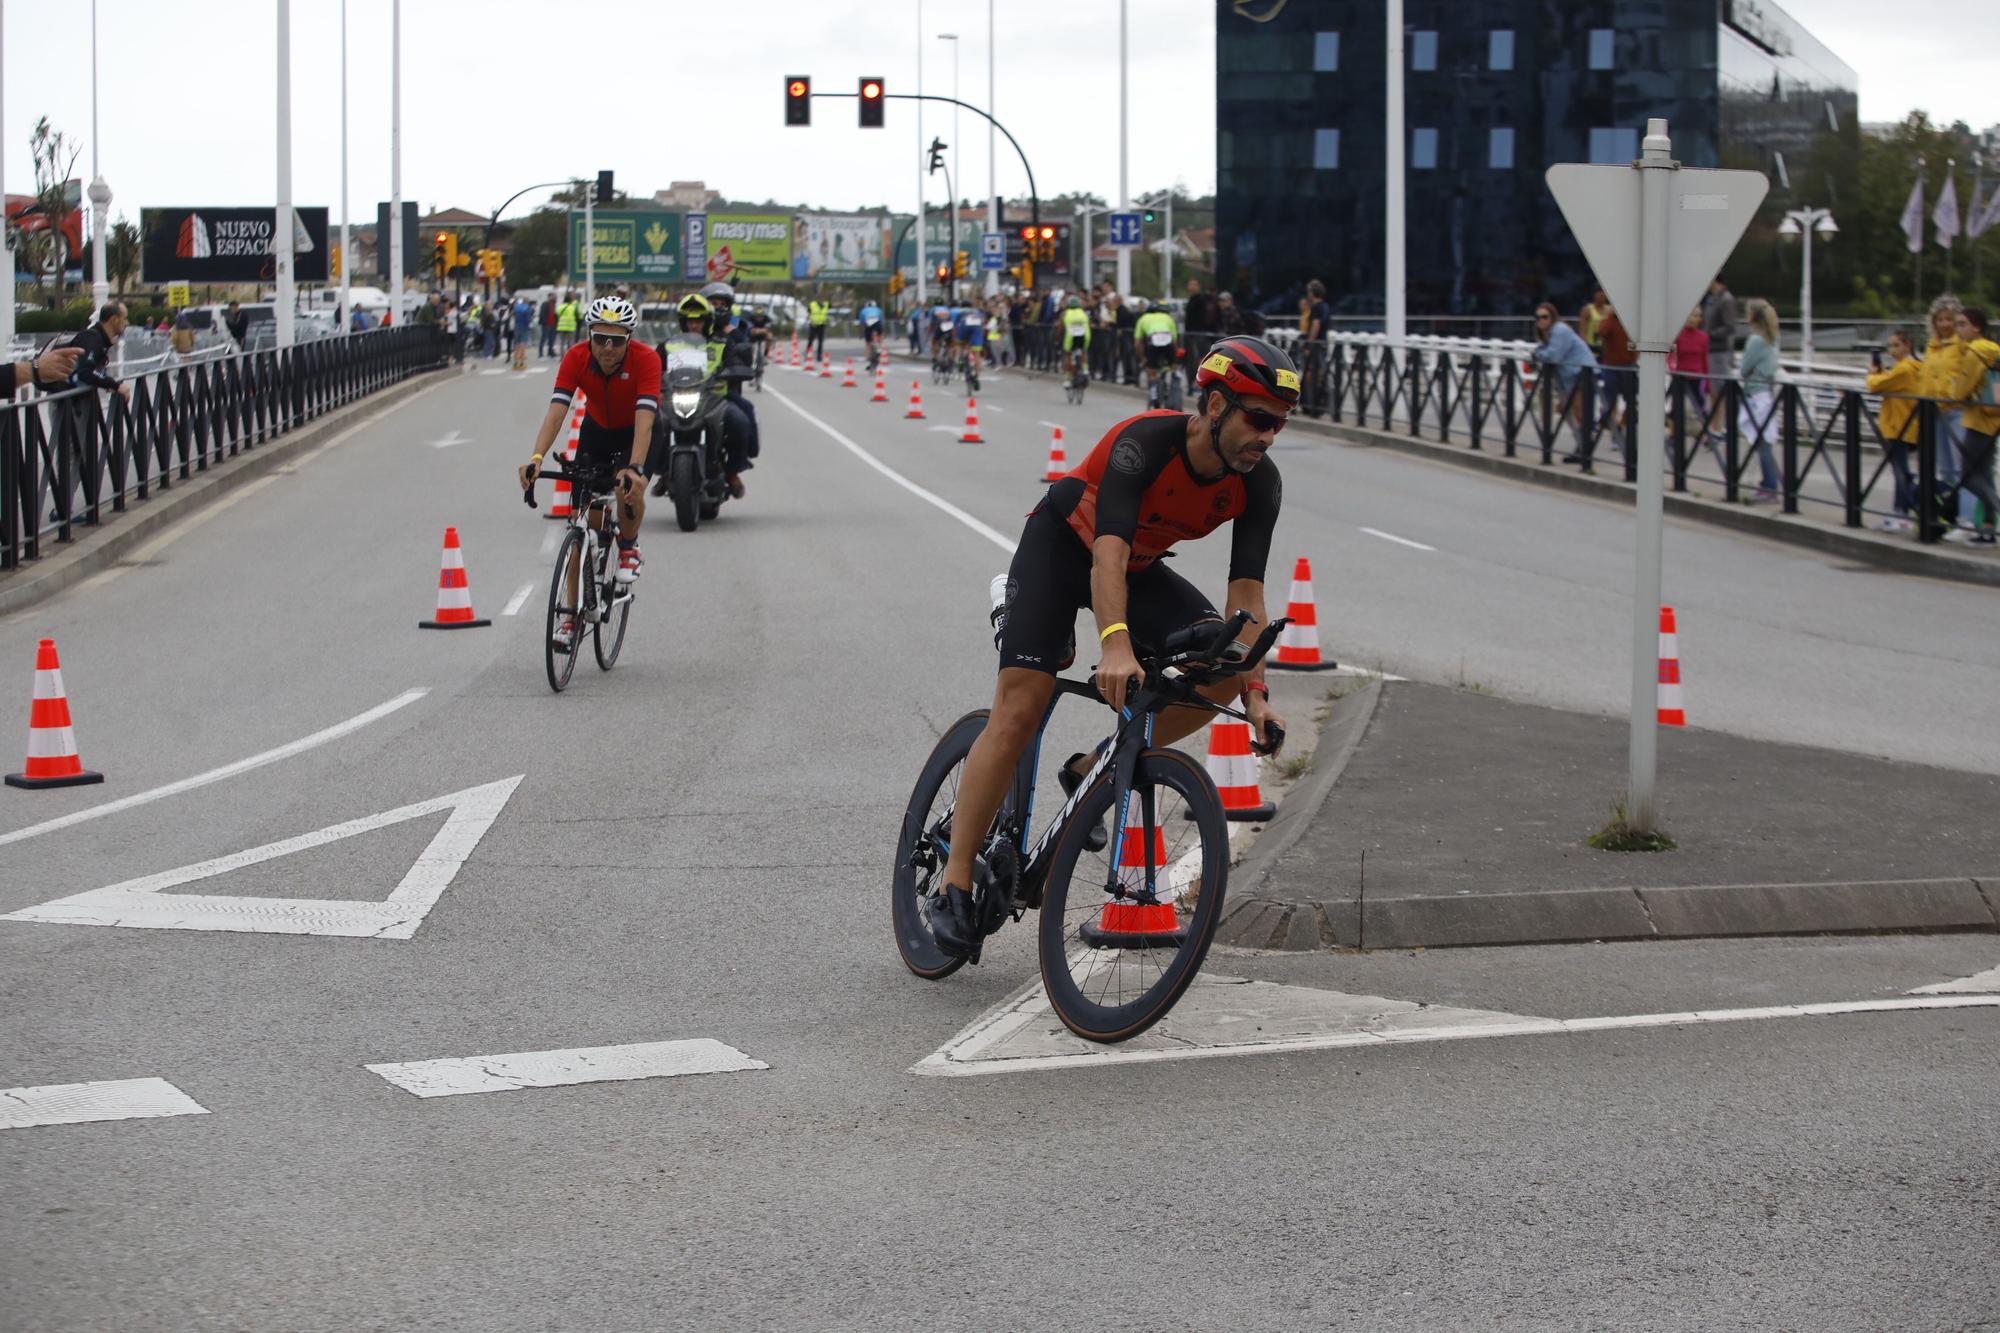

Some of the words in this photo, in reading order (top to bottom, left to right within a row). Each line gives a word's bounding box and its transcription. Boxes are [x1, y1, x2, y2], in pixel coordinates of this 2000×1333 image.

[215, 221, 270, 238] NUEVO
[712, 222, 787, 243] masymas
[215, 239, 270, 256] ESPACI
[581, 246, 630, 264] EPRESAS
[1024, 729, 1120, 872] STEVENS
[1120, 787, 1131, 832] STEVENS
